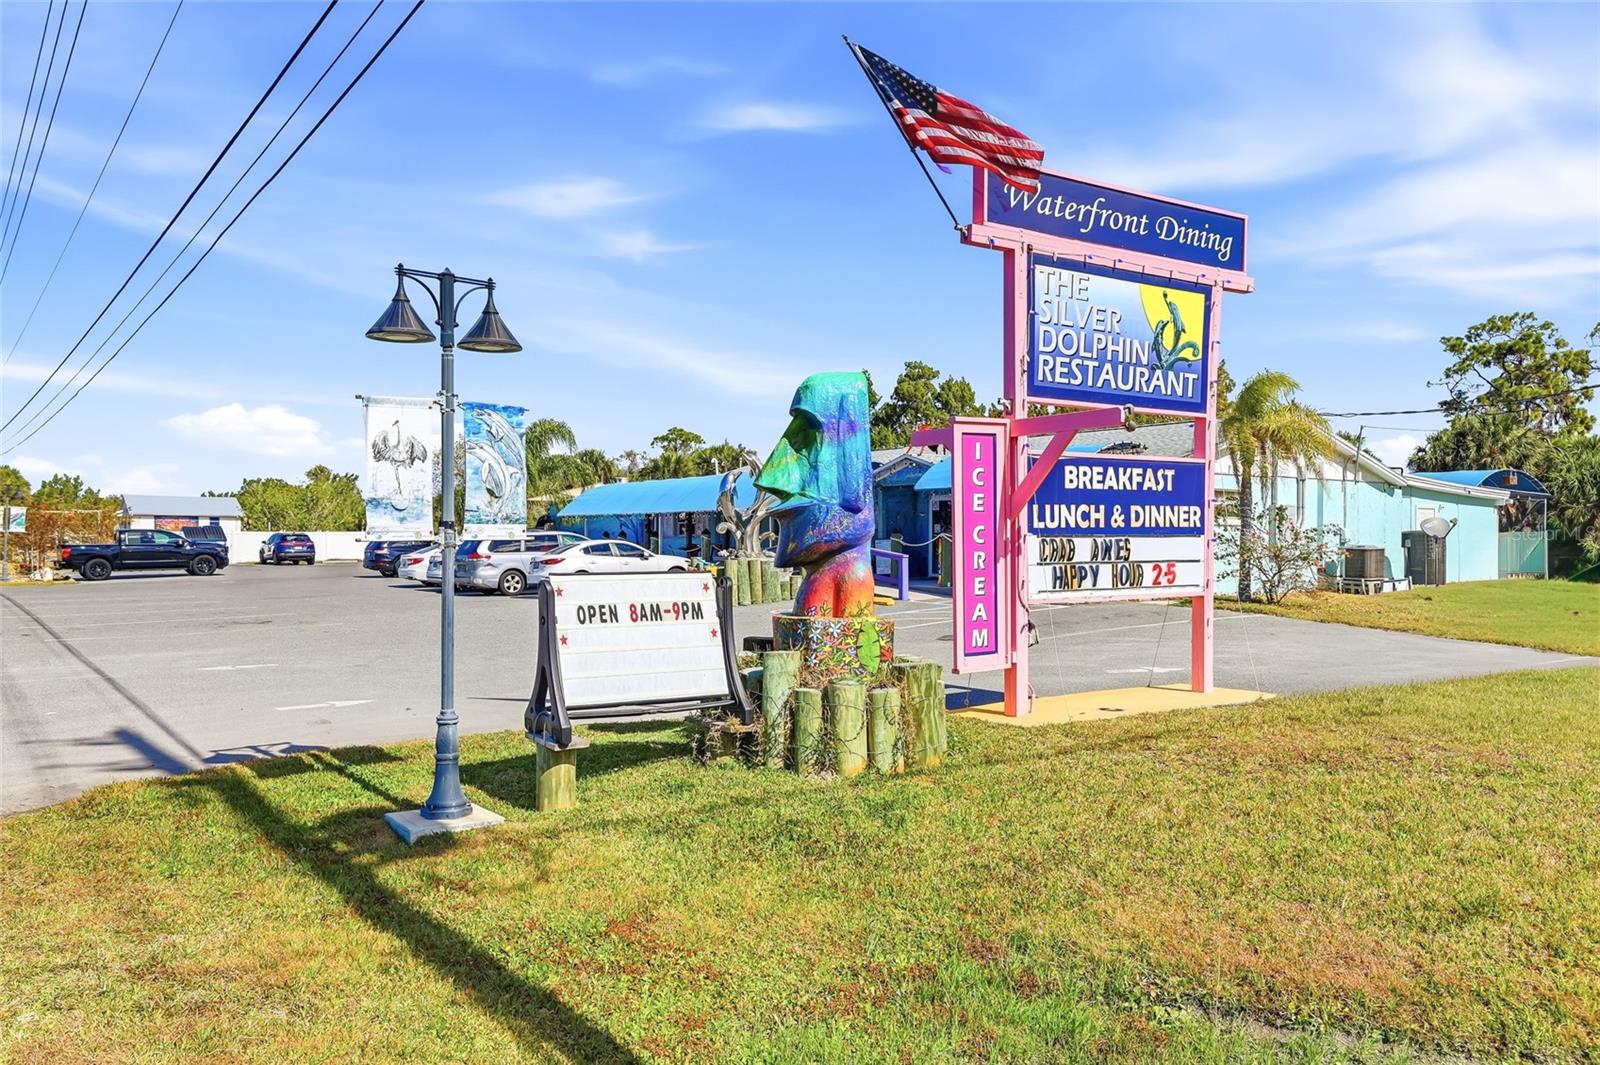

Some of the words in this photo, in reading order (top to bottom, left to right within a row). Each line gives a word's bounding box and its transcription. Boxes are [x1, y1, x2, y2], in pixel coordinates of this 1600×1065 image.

[1004, 182, 1149, 235] Waterfront
[1155, 215, 1234, 261] Dining
[1039, 269, 1090, 302] THE
[1038, 299, 1122, 335] SILVER
[1038, 325, 1151, 366] DOLPHIN
[1037, 354, 1199, 398] RESTAURANT
[972, 442, 985, 512] ICE
[1064, 465, 1176, 492] BREAKFAST
[1033, 504, 1106, 529] LUNCH
[1110, 504, 1126, 528] &
[1130, 504, 1202, 528] DINNER
[971, 525, 988, 649] CREAM
[1051, 564, 1100, 590] HAPPY
[1111, 562, 1144, 587] HOUR
[576, 603, 619, 625] OPEN
[629, 601, 704, 623] 8AM-9PM
